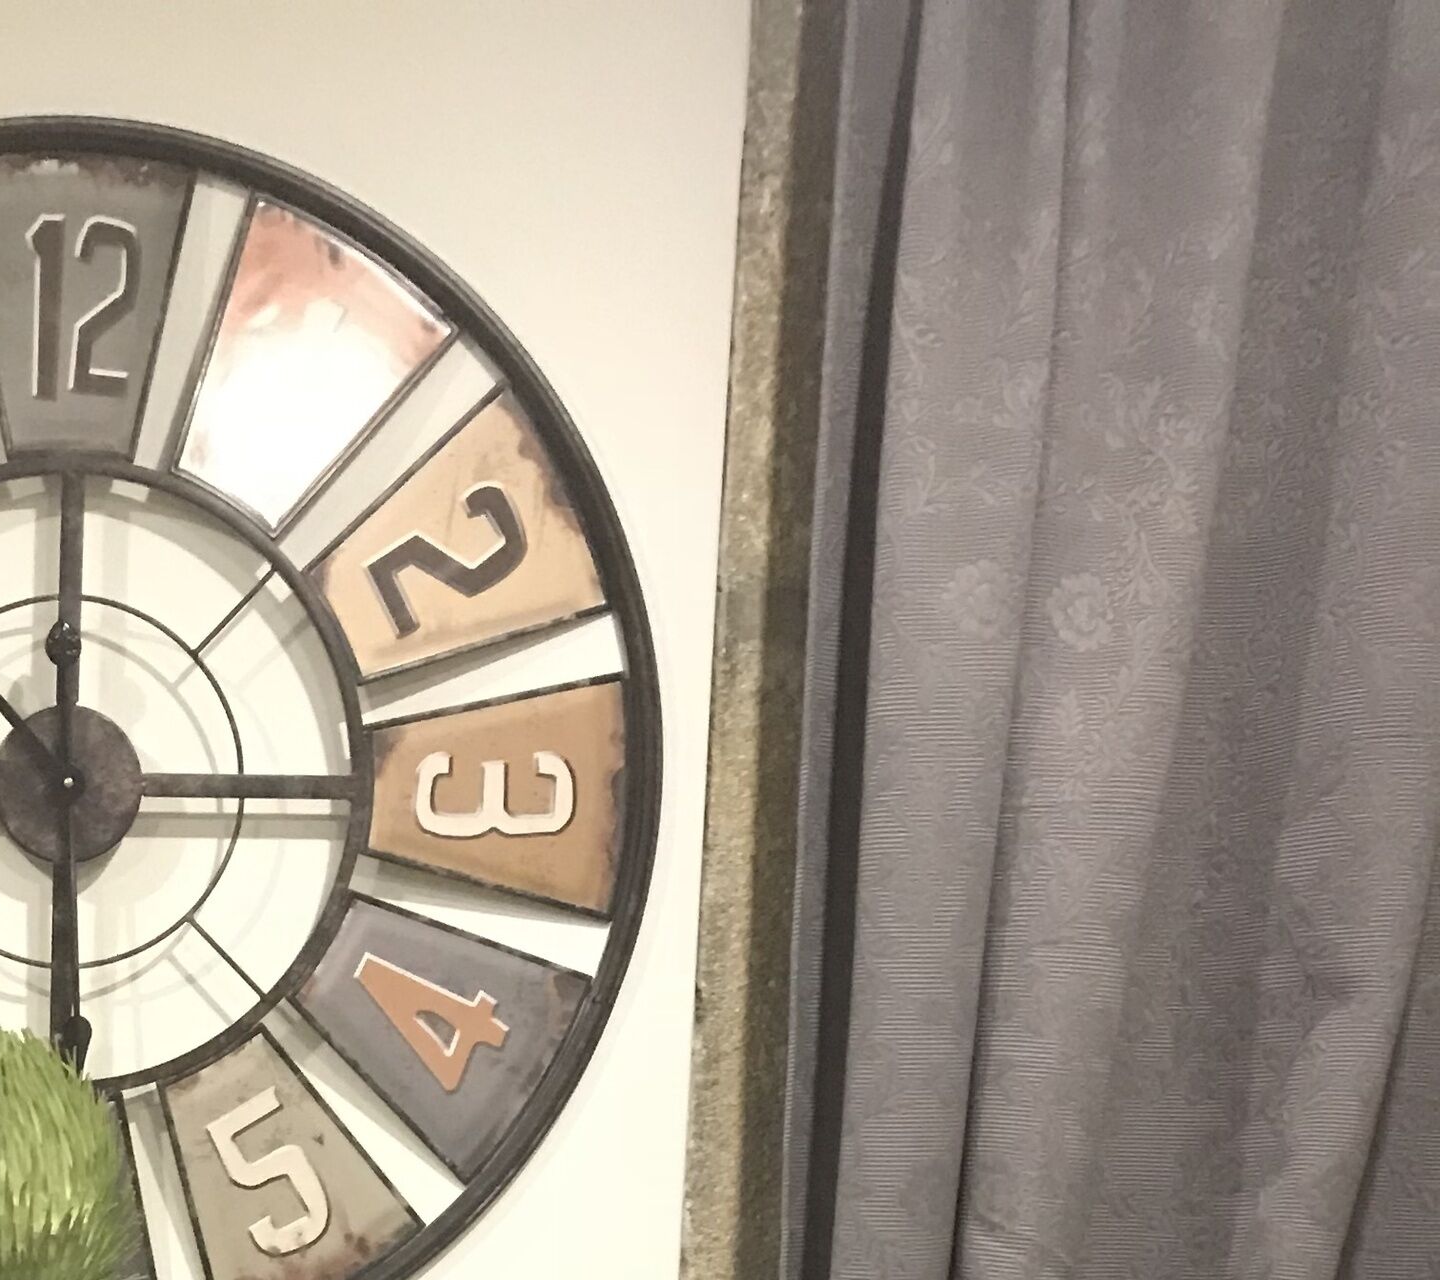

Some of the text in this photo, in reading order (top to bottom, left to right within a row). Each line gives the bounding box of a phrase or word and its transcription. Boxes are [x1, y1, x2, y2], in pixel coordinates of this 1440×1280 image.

[23, 212, 139, 402] 12
[363, 481, 530, 640] 2
[414, 750, 576, 838] 3
[354, 952, 510, 1093] 4
[205, 1086, 332, 1258] 5
